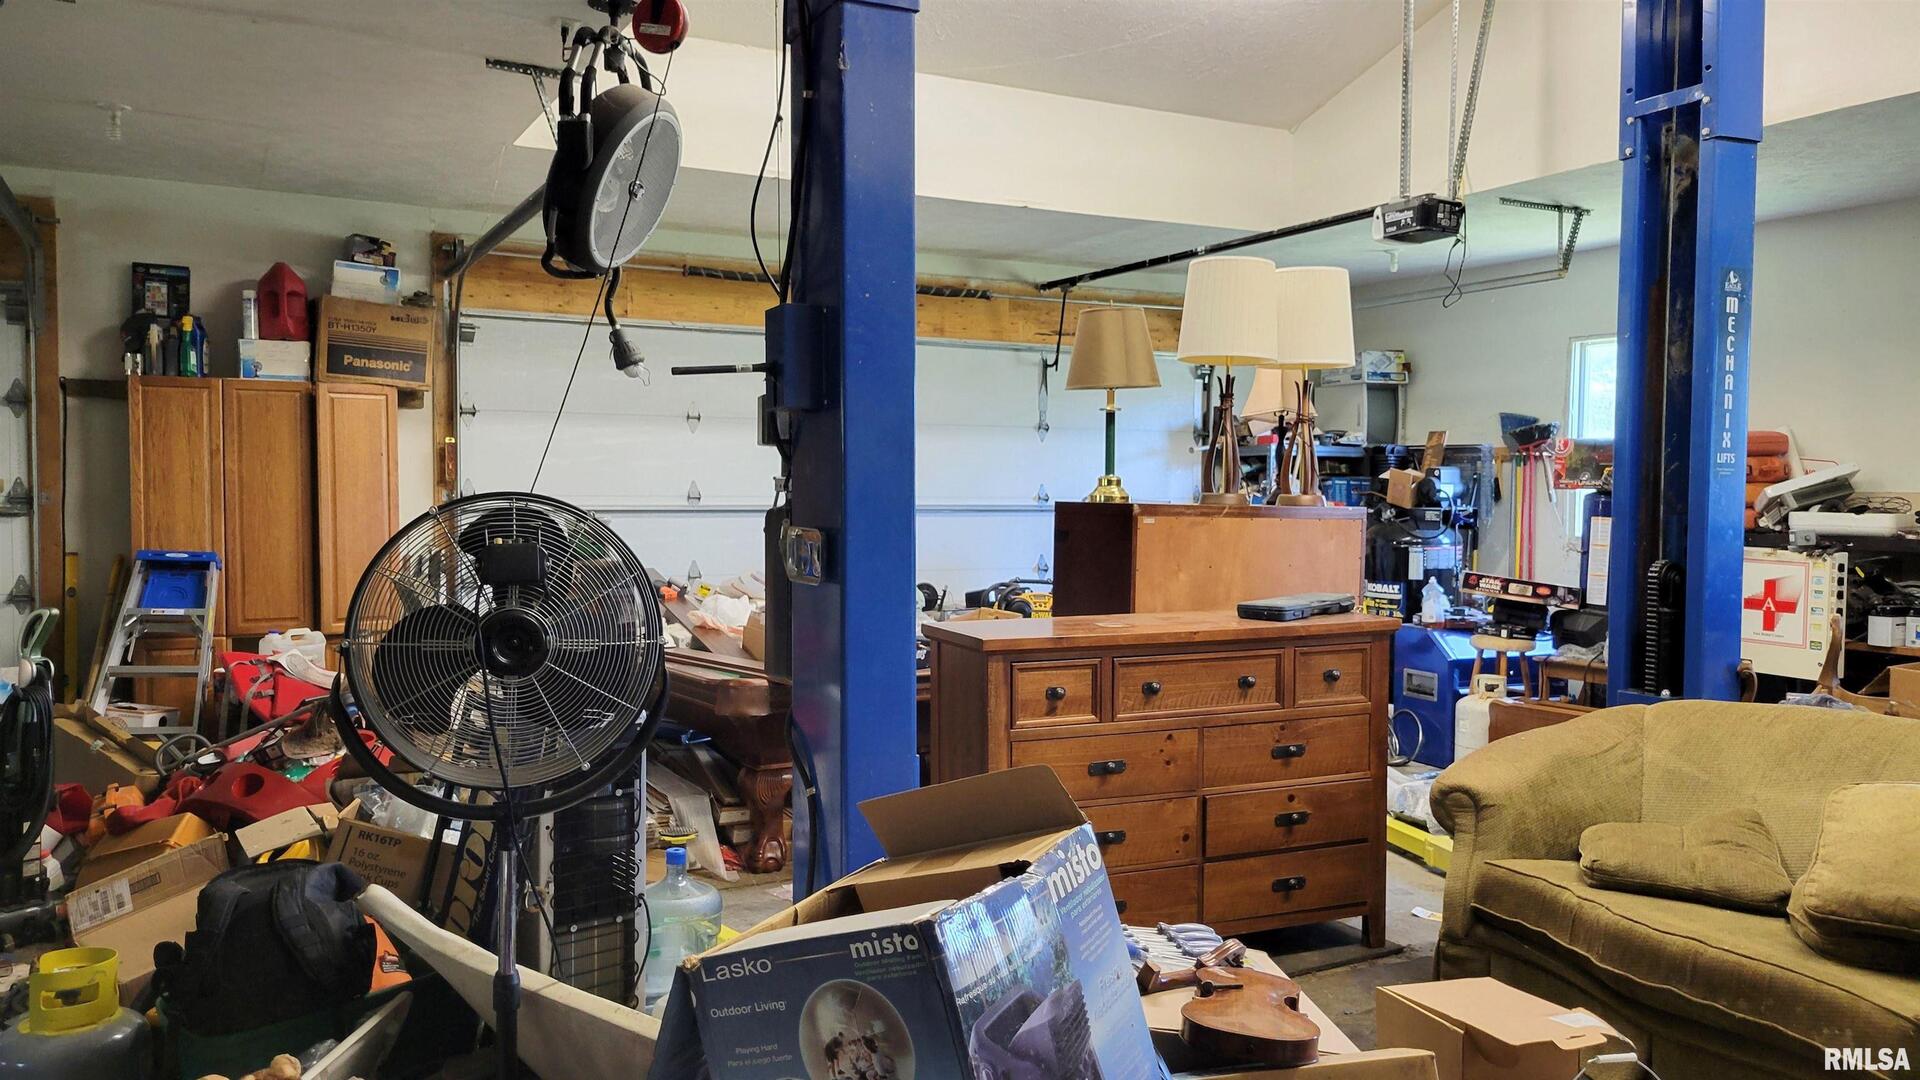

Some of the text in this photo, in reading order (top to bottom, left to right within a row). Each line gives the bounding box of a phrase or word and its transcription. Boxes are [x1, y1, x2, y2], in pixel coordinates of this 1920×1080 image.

[343, 354, 412, 372] Panasonic
[1722, 296, 1739, 449] MECHANIX
[1716, 452, 1736, 464] LIFTS
[1367, 582, 1400, 594] KOBALT
[358, 829, 402, 848] RK16TP
[353, 847, 366, 858] 16
[349, 857, 407, 879] Polystyrene
[1046, 843, 1102, 905] misto
[849, 931, 919, 959] misto
[700, 957, 772, 982] Lasko
[710, 1000, 786, 1018] Outdoor Living
